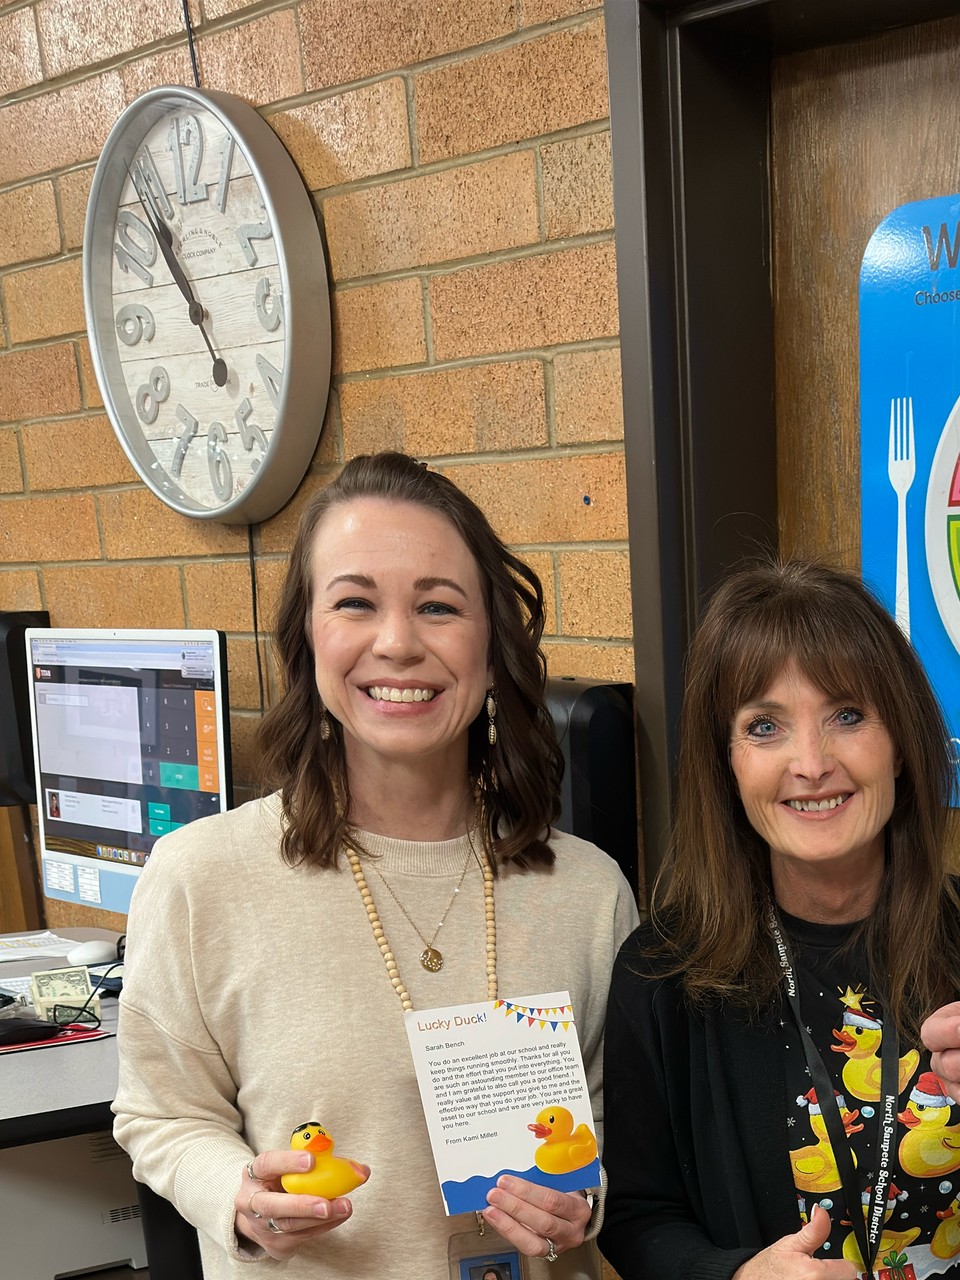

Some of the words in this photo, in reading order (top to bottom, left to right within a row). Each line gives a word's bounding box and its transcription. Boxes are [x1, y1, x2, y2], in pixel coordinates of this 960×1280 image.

[168, 114, 209, 206] 12
[215, 132, 236, 214] 1
[113, 210, 157, 287] 10
[182, 252, 196, 260] CLOCK
[196, 247, 216, 257] COMPANY
[255, 277, 285, 332] 3
[115, 303, 156, 346] 9
[135, 365, 171, 425] 8
[170, 403, 199, 480] 7
[234, 397, 269, 475] 5
[207, 421, 233, 501] 6
[418, 1019, 450, 1031] Lucky
[454, 1013, 487, 1026] Duck!
[461, 1054, 488, 1062] excellent
[518, 1046, 537, 1054] school
[467, 1062, 489, 1070] running
[463, 1085, 486, 1095] grateful
[537, 1075, 552, 1083] good
[471, 1076, 504, 1085] astounding
[492, 1090, 515, 1098] support
[439, 1106, 464, 1114] effective
[568, 1086, 583, 1094] great
[441, 1114, 458, 1122] asset
[477, 1108, 497, 1116] school
[883, 1095, 895, 1126] North
[881, 1126, 894, 1168] Sanpete
[875, 1170, 889, 1204] School
[869, 1206, 883, 1244] District
